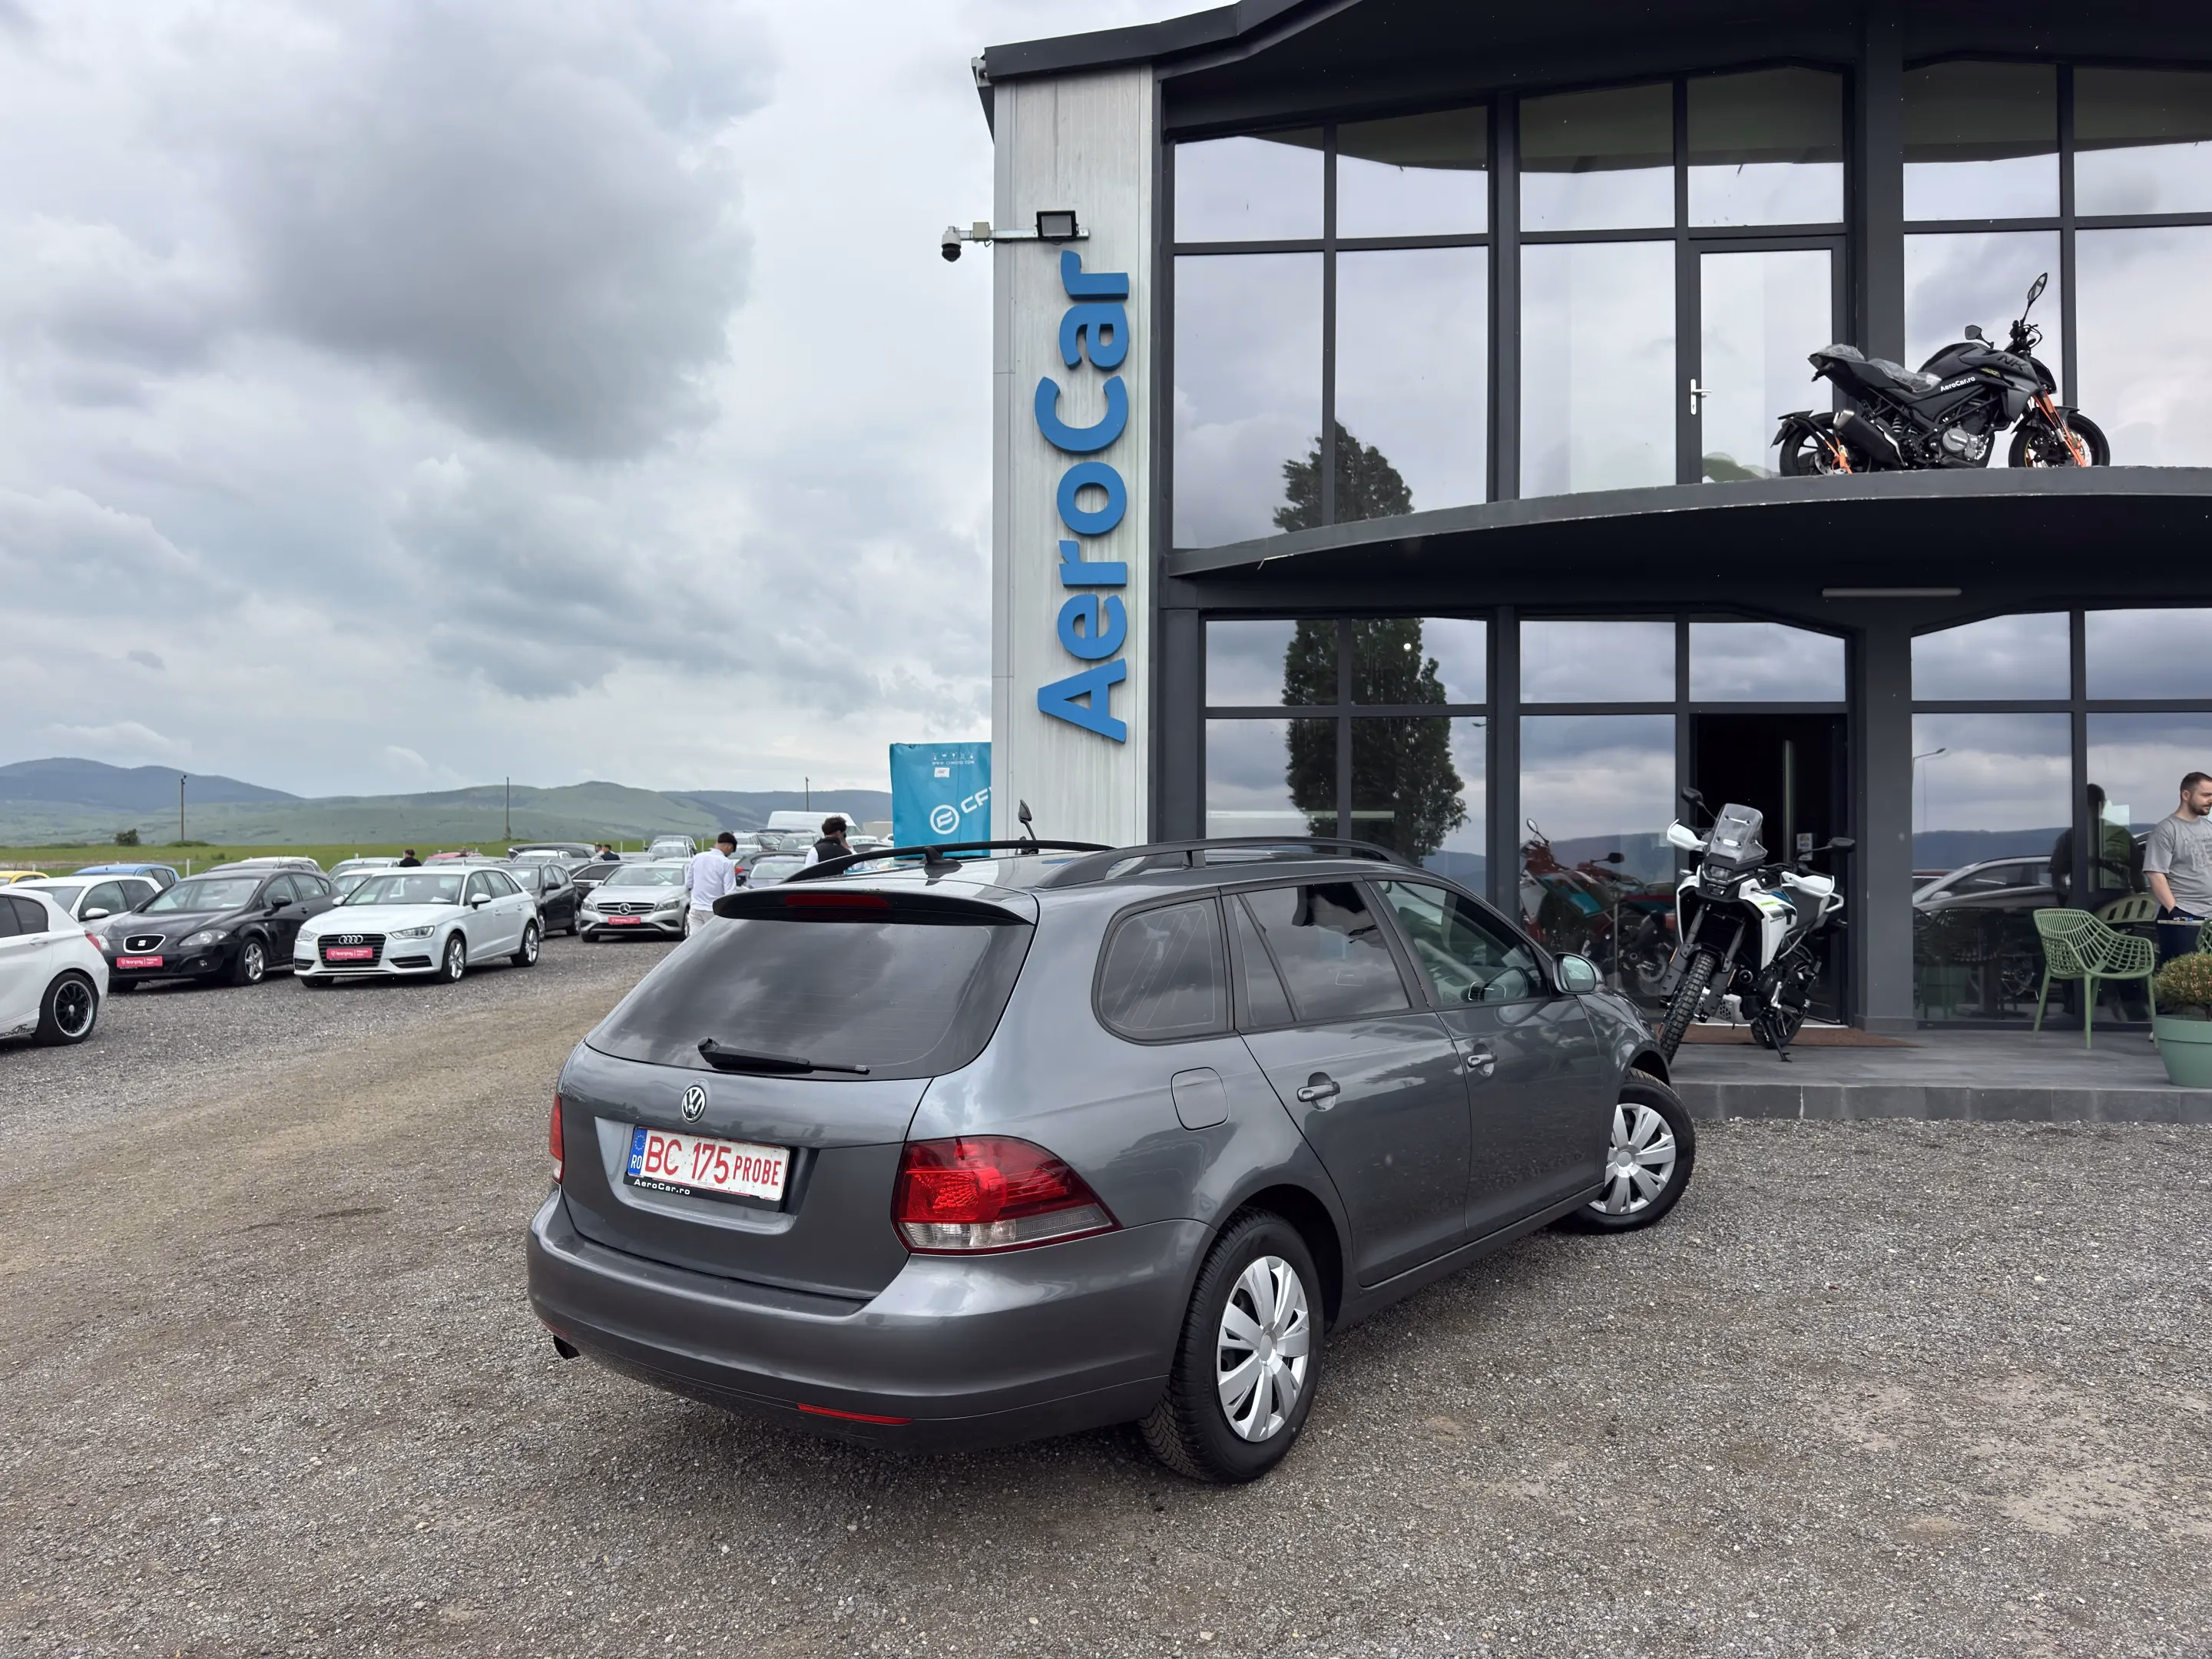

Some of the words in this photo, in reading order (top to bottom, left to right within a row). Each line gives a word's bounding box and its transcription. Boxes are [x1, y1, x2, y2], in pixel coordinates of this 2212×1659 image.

[1940, 376, 1976, 392] AeroCar.ro
[1035, 250, 1130, 743] AeroCar
[960, 786, 991, 813] CF
[631, 1154, 642, 1170] RO
[645, 1135, 682, 1175] BC
[691, 1142, 731, 1184] 175
[733, 1155, 782, 1186] PROBE
[634, 1179, 690, 1195] AeroCar.ro
